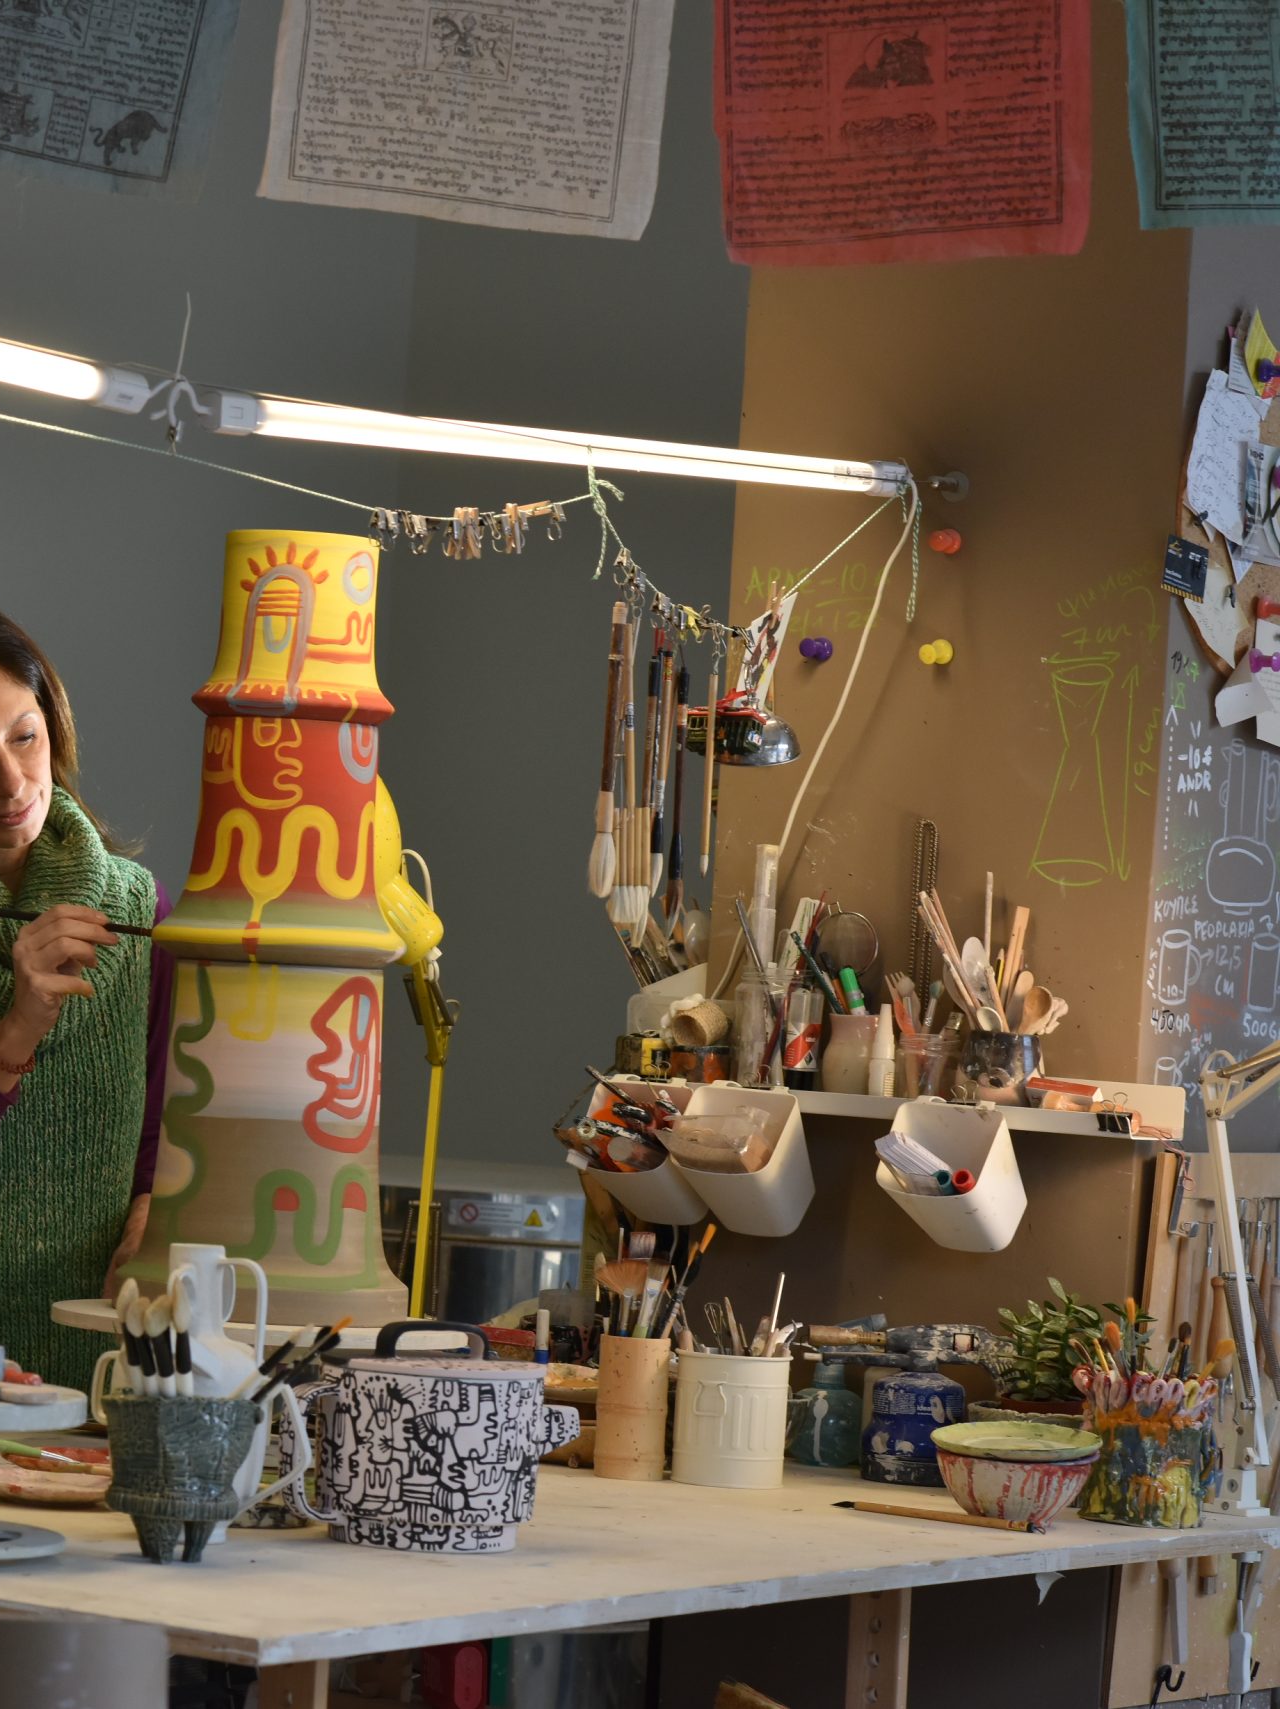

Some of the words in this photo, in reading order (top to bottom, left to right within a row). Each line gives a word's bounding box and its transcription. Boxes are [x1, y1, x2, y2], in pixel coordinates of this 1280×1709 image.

[1176, 770, 1212, 794] ANDR
[1215, 945, 1242, 971] 12,5
[1243, 1014, 1280, 1041] 500G
